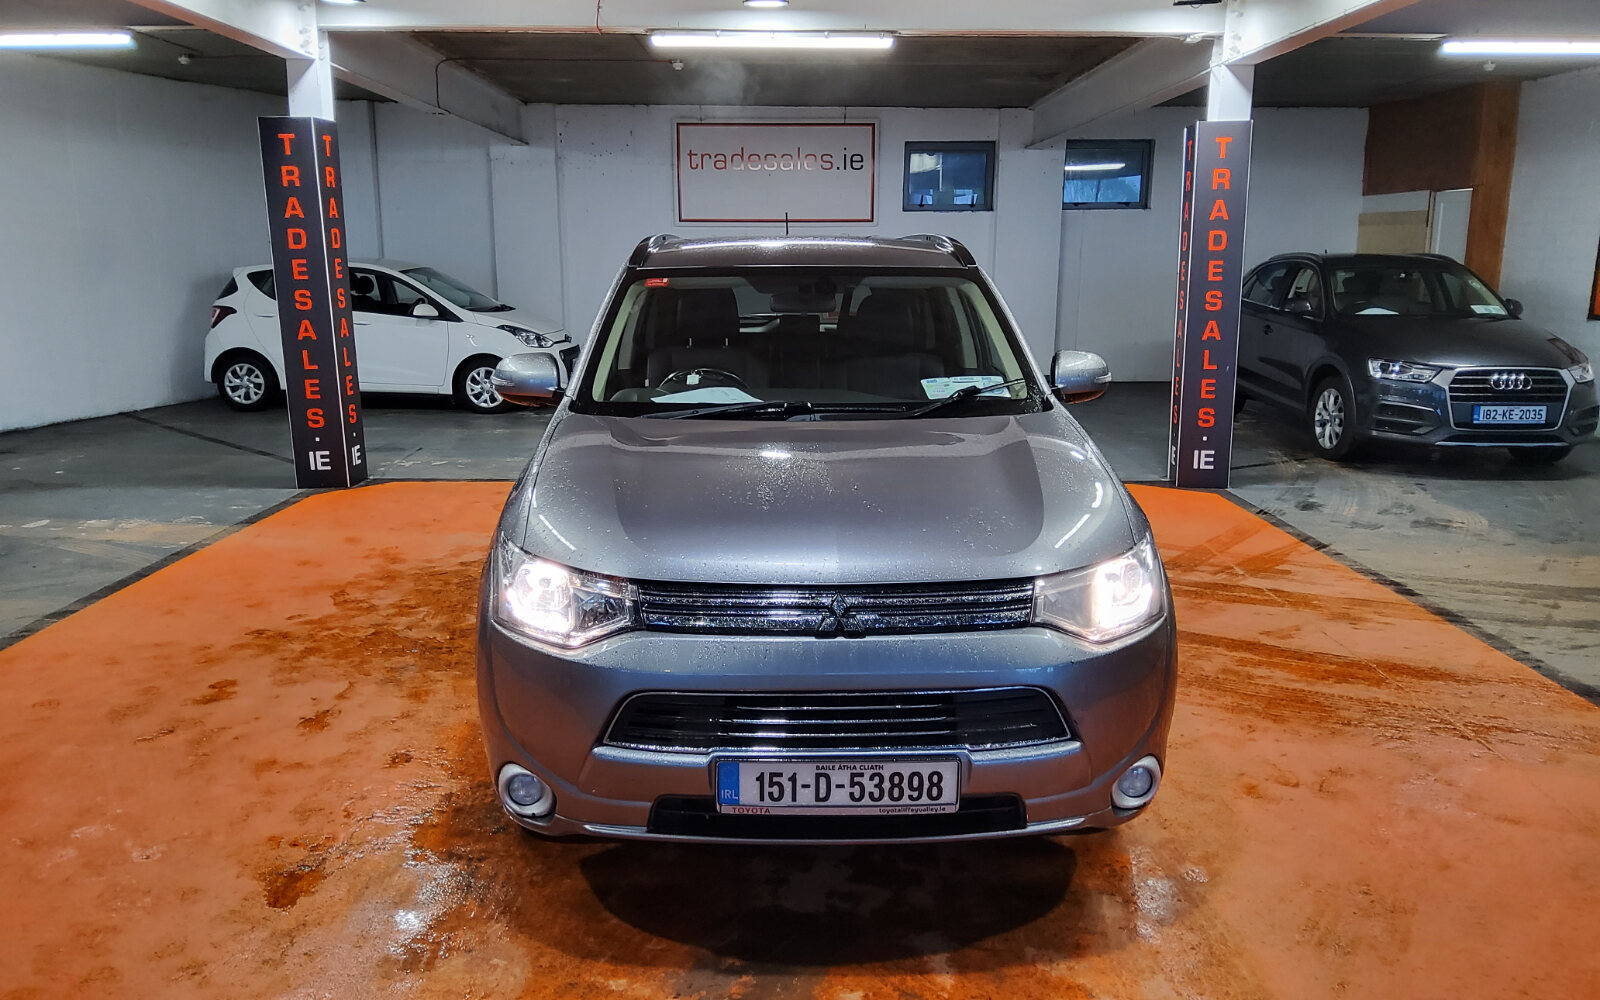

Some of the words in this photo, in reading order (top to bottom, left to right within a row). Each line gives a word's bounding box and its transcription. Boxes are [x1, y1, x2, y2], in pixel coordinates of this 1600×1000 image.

[687, 146, 865, 171] tradesales.ie
[1482, 409, 1544, 420] 182-KE-2035
[837, 763, 857, 771] ÁTHA
[755, 770, 944, 803] 151-D-53898
[721, 788, 739, 800] IRL
[732, 807, 771, 815] TOYOTA
